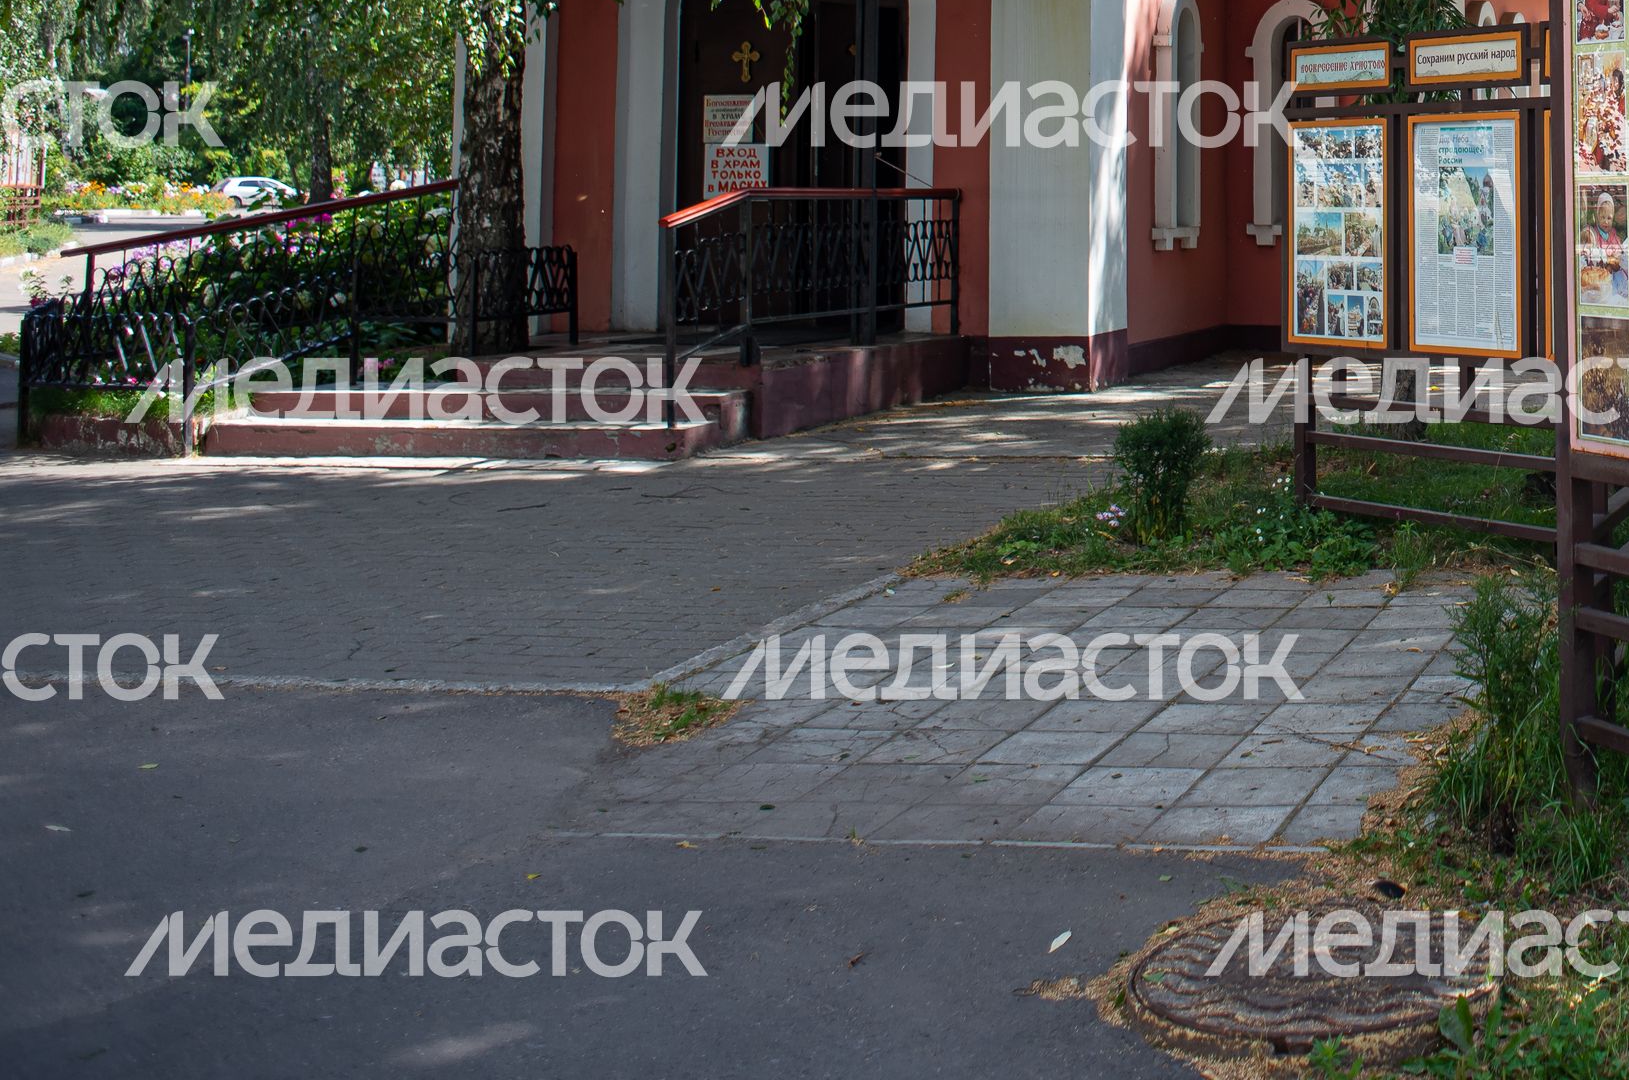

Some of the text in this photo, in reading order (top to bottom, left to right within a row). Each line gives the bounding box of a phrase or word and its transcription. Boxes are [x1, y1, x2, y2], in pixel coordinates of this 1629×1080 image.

[1417, 50, 1455, 66] Сохраним
[1457, 48, 1488, 64] русский
[716, 148, 757, 159] ВХОД
[711, 160, 760, 169] В ХРАМ
[1439, 156, 1463, 164] России
[712, 170, 761, 179] ТОЛЬКО
[718, 180, 767, 193] МАСКАХ
